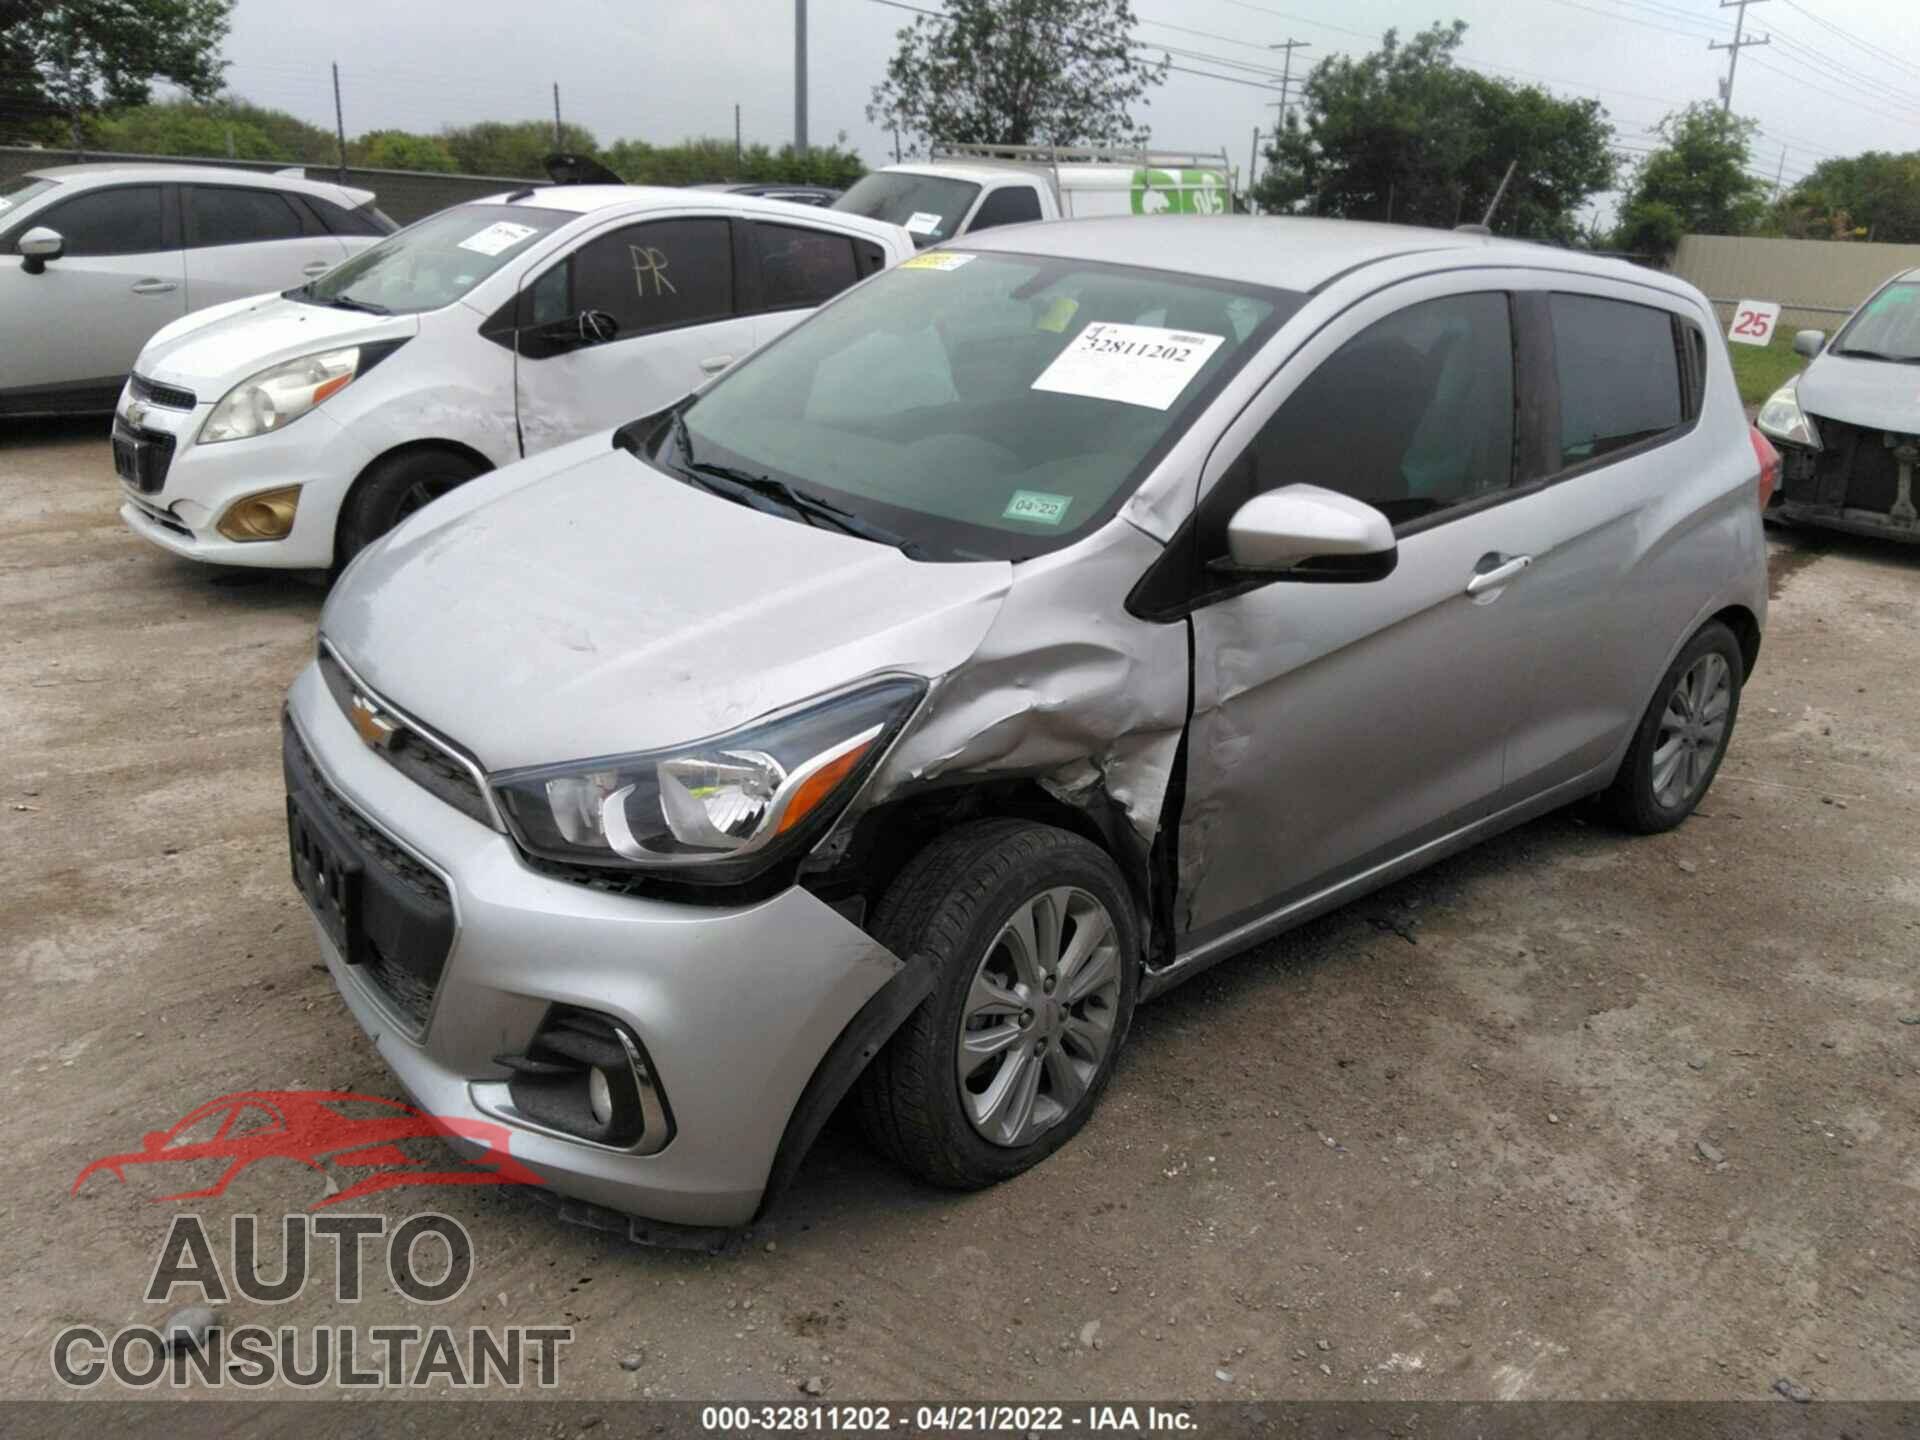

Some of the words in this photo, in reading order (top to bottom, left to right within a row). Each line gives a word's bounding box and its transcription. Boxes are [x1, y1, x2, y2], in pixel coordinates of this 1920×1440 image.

[628, 243, 677, 296] PR
[1735, 310, 1771, 337] 25
[1082, 339, 1191, 362] 32811202
